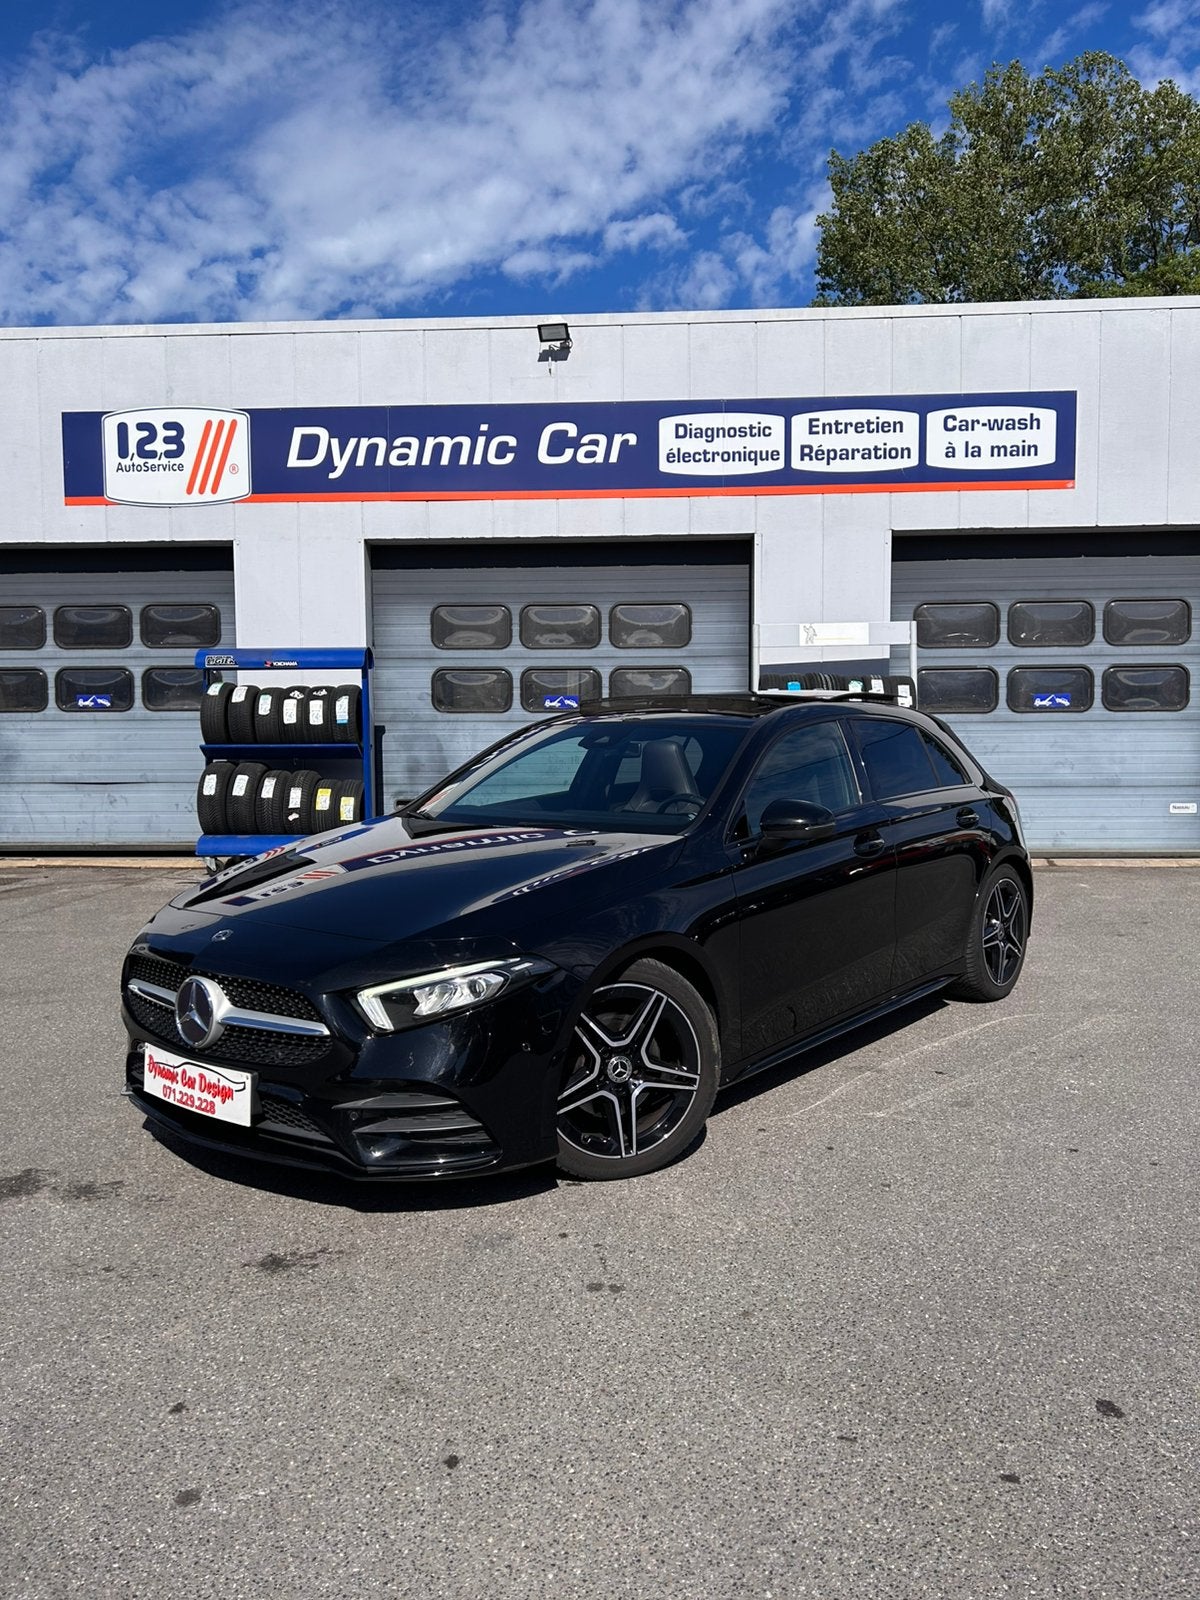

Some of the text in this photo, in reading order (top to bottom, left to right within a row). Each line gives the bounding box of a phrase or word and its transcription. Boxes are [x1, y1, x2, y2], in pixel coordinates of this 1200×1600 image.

[674, 421, 772, 444] Diagnostic
[808, 416, 904, 435] Entretien
[943, 412, 1041, 432] Car-wash
[286, 422, 638, 479] Dynamic Car
[666, 446, 781, 466] électronique
[799, 443, 912, 466] Réparation
[944, 439, 1038, 459] à la main
[115, 461, 184, 473] AutoService
[147, 1054, 234, 1105] Dynamic Car Design
[162, 1084, 216, 1116] 071.229.228
